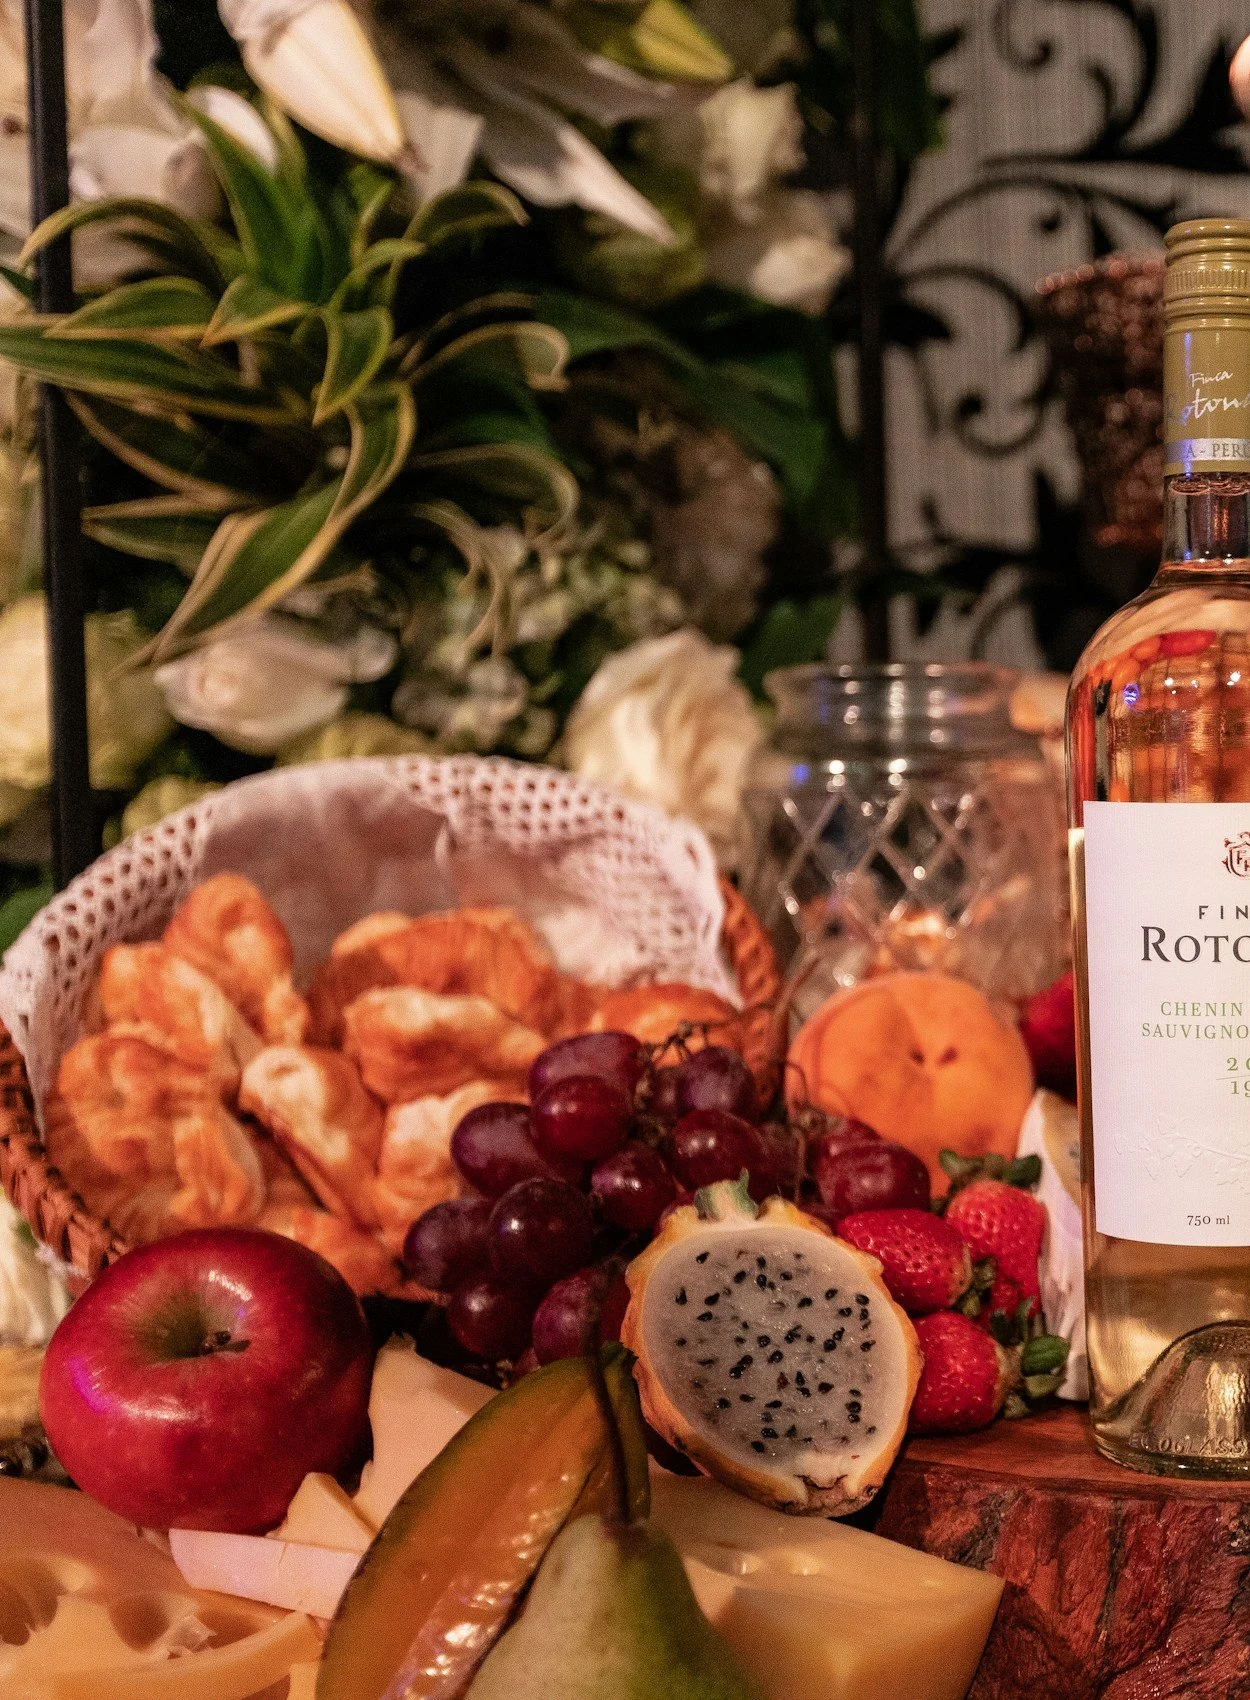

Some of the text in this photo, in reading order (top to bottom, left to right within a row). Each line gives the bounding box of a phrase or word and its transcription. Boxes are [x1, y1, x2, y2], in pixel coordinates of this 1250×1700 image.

[1189, 370, 1233, 388] Finca
[1160, 1001, 1244, 1018] CHENIN
[1187, 1215, 1212, 1227] 750
[1215, 1214, 1231, 1225] ml
